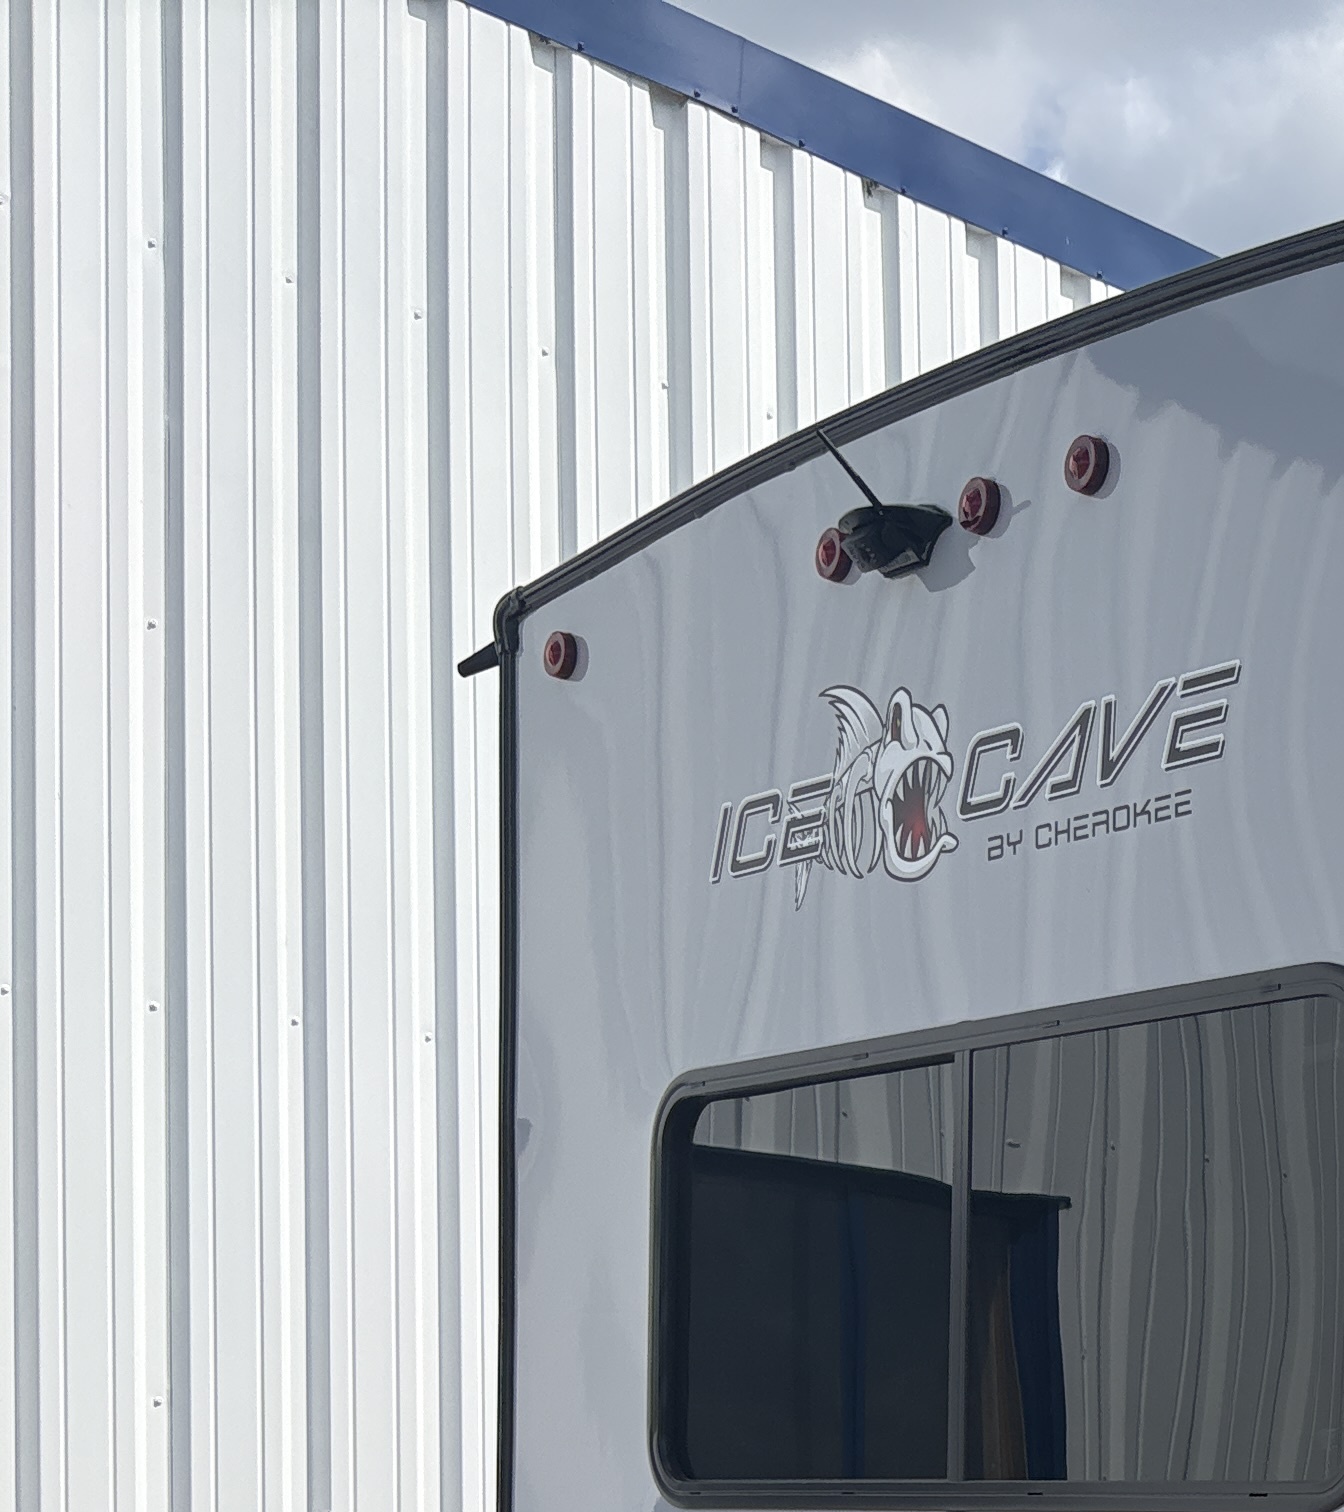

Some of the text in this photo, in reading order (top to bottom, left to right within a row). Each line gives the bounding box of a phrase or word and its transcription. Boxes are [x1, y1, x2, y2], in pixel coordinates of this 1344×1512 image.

[708, 659, 1242, 885] ICE CAVE
[987, 788, 1195, 862] BY CHEROKEE
